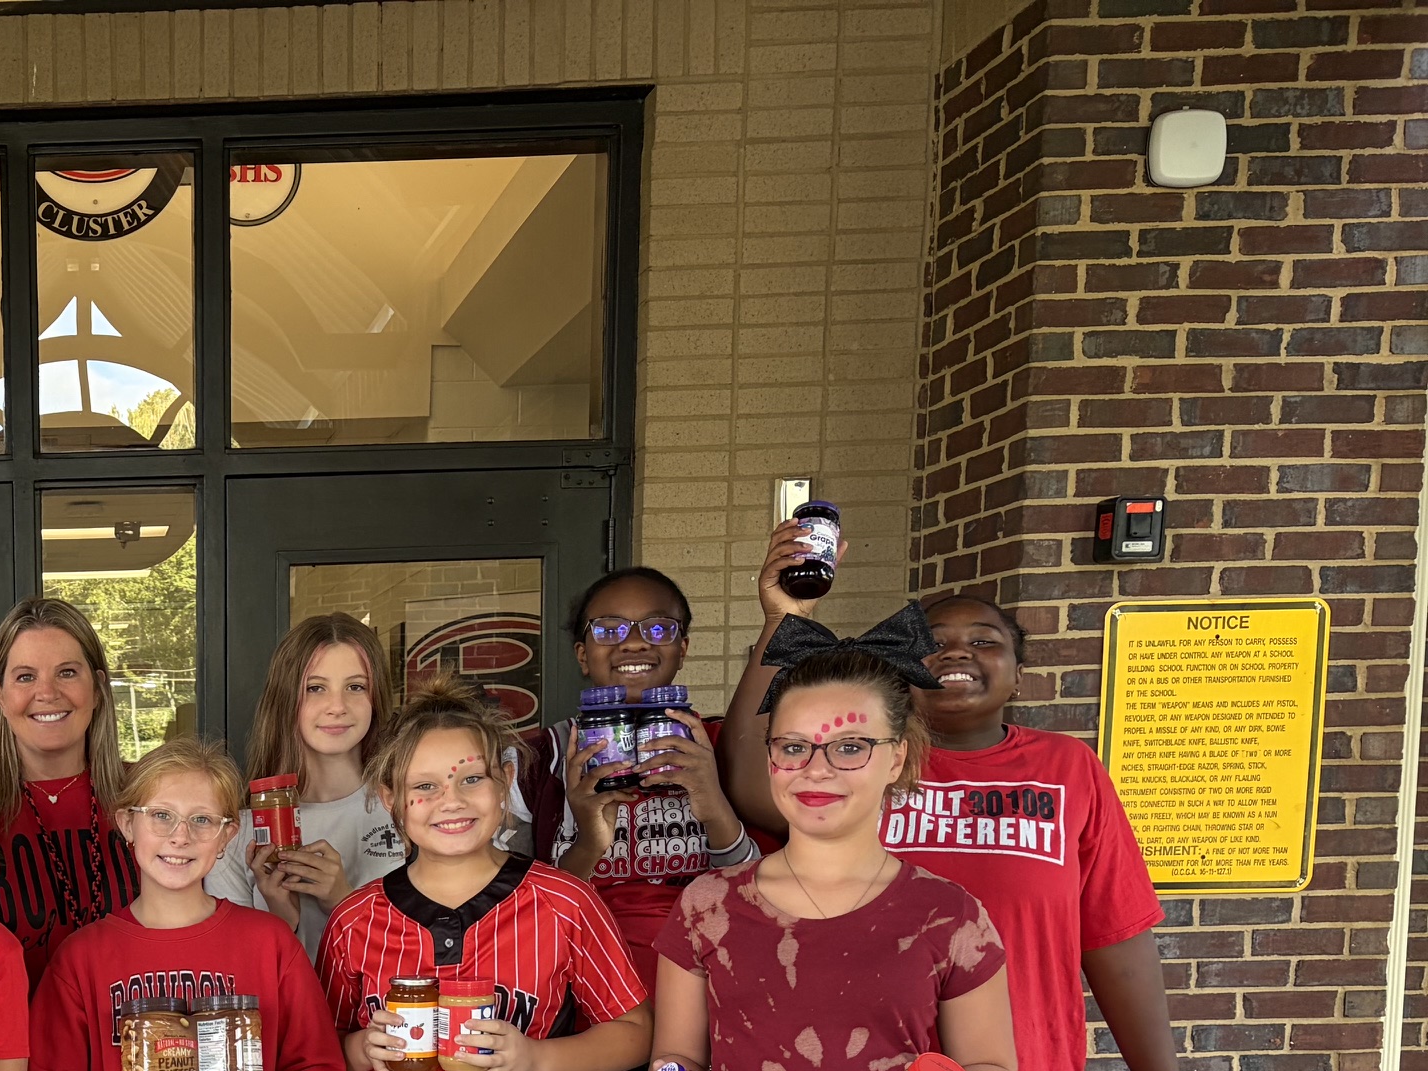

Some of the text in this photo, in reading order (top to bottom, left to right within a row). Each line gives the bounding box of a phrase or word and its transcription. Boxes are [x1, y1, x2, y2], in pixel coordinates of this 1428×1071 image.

[37, 199, 156, 237] CLUSTER
[1186, 615, 1250, 630] NOTICE
[1128, 640, 1134, 648] IT
[1137, 640, 1143, 648] IS
[1145, 639, 1176, 647] UNLAWFUL
[1179, 639, 1191, 647] FOR
[1194, 639, 1206, 647] ANY
[1208, 638, 1232, 647] PERSON
[1235, 638, 1243, 646] TO
[1269, 637, 1298, 645] POSSESS
[1128, 650, 1295, 660] OR HAVE UNDER CONTROL ANY WEAPON AT A SCHOOL
[1127, 662, 1299, 673] BUILDING SCHOOL FUNCTION OR ON SCHOOL PROPERTY
[1126, 674, 1292, 686] OR ON A BUS OR OTHER TRANSPORTATION FURNISHED
[1125, 690, 1135, 698] BY
[1137, 689, 1148, 697] THE
[968, 788, 1056, 820] 30108
[884, 812, 1056, 854] DIFFERENT
[1212, 847, 1226, 855] FINE
[1227, 847, 1236, 855] OF
[1238, 847, 1250, 855] NOT
[1252, 847, 1270, 855] MORE
[1272, 846, 1289, 855] THAN
[162, 1048, 192, 1058] CREAMY
[158, 1055, 195, 1068] PEANUT
